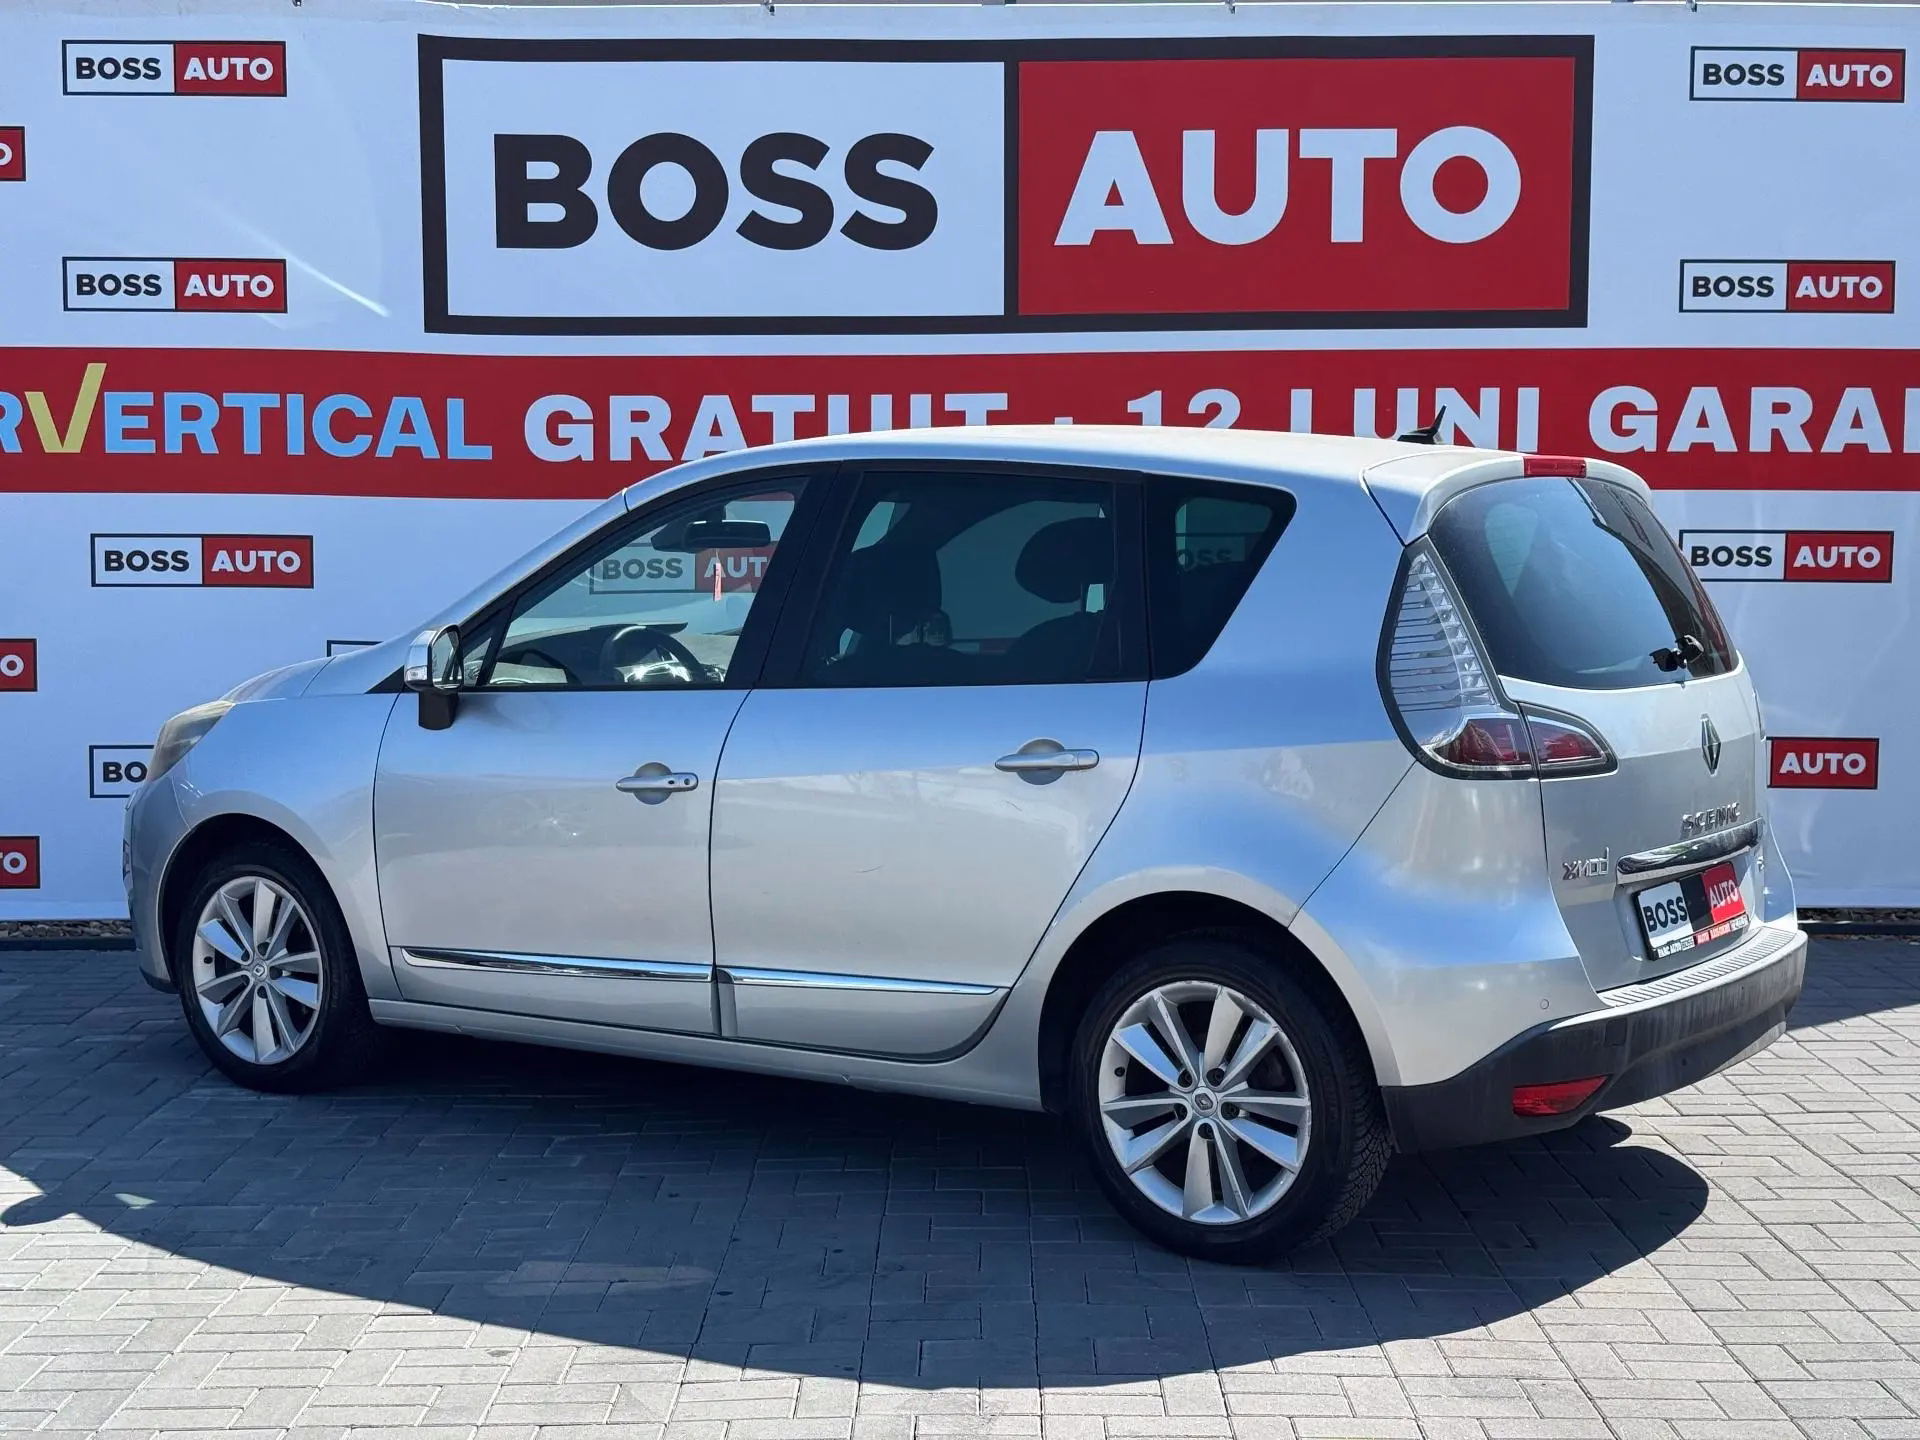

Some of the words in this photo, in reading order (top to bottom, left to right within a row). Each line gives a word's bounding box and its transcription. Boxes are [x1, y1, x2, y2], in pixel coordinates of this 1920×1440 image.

[75, 57, 162, 81] BOSS
[184, 57, 274, 81] AUTO
[1702, 63, 1785, 86] BOSS
[1805, 64, 1893, 88] AUTO
[494, 132, 938, 251] BOSS
[1054, 125, 1522, 246] AUTO
[76, 273, 162, 297] BOSS
[184, 274, 274, 298] AUTO
[1692, 275, 1775, 298] BOSS
[1795, 275, 1883, 299] AUTO
[1127, 388, 1242, 430] 12
[104, 549, 190, 572] BOSS
[211, 550, 301, 573] AUTO
[602, 557, 684, 580] BOSS
[703, 556, 770, 578] AUT
[1690, 545, 1773, 567] BOSS
[1793, 545, 1881, 569] AUTO
[102, 761, 148, 783] BO
[1779, 752, 1866, 775] AUTO
[1642, 896, 1688, 933] BOSS
[1709, 879, 1739, 908] AUTO
